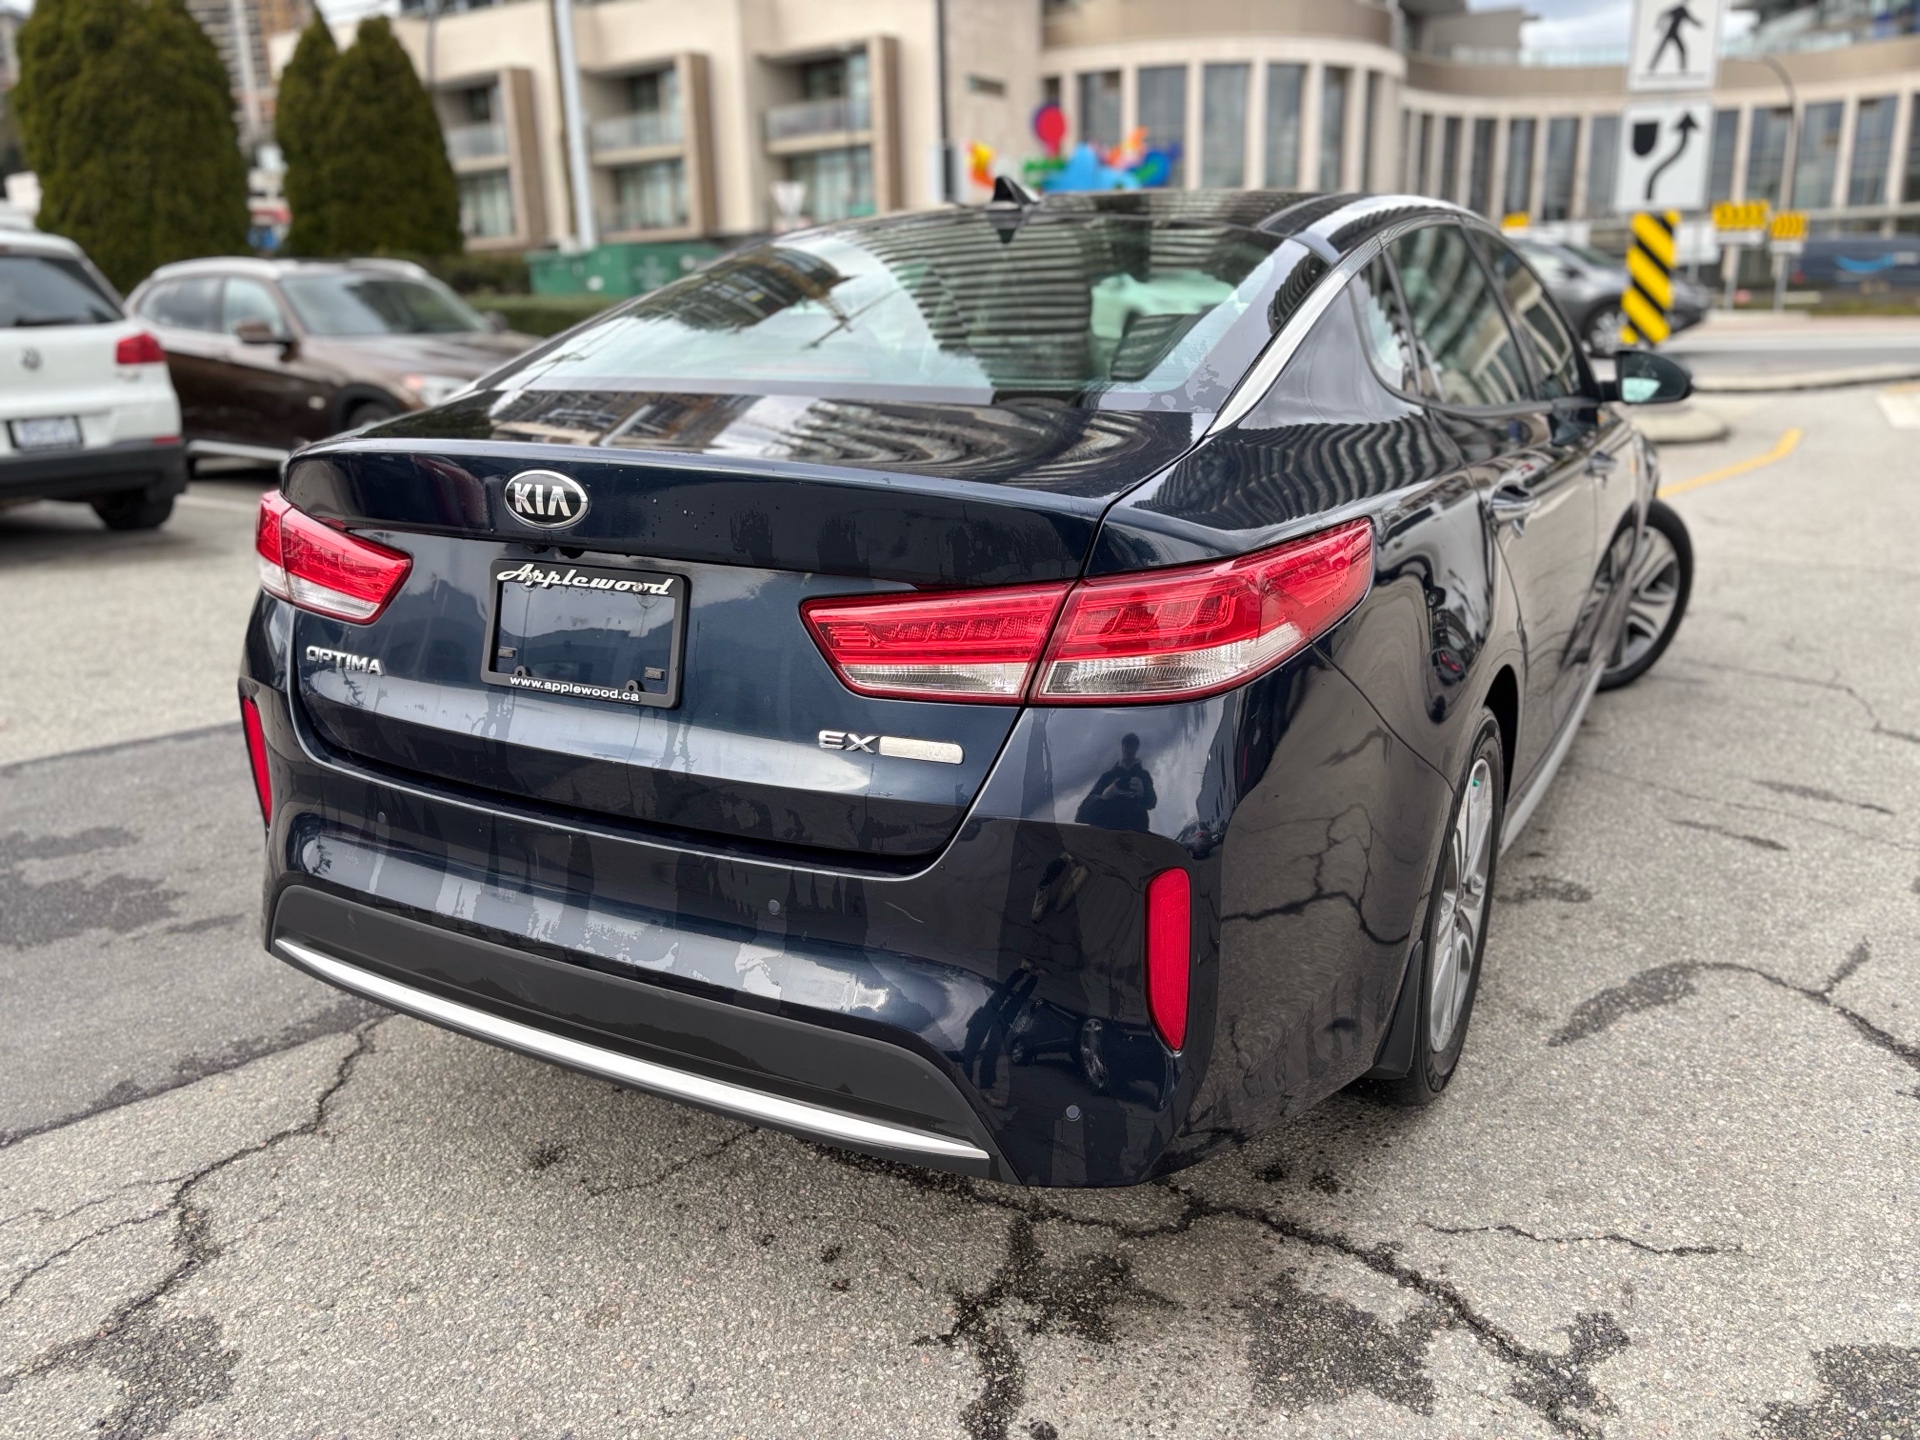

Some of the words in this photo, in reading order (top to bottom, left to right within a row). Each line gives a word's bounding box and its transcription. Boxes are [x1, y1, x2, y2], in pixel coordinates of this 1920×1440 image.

[514, 483, 571, 516] KIA
[306, 645, 383, 676] OPTIMA
[509, 676, 640, 702] www.applewood.ca
[818, 729, 879, 754] EX
